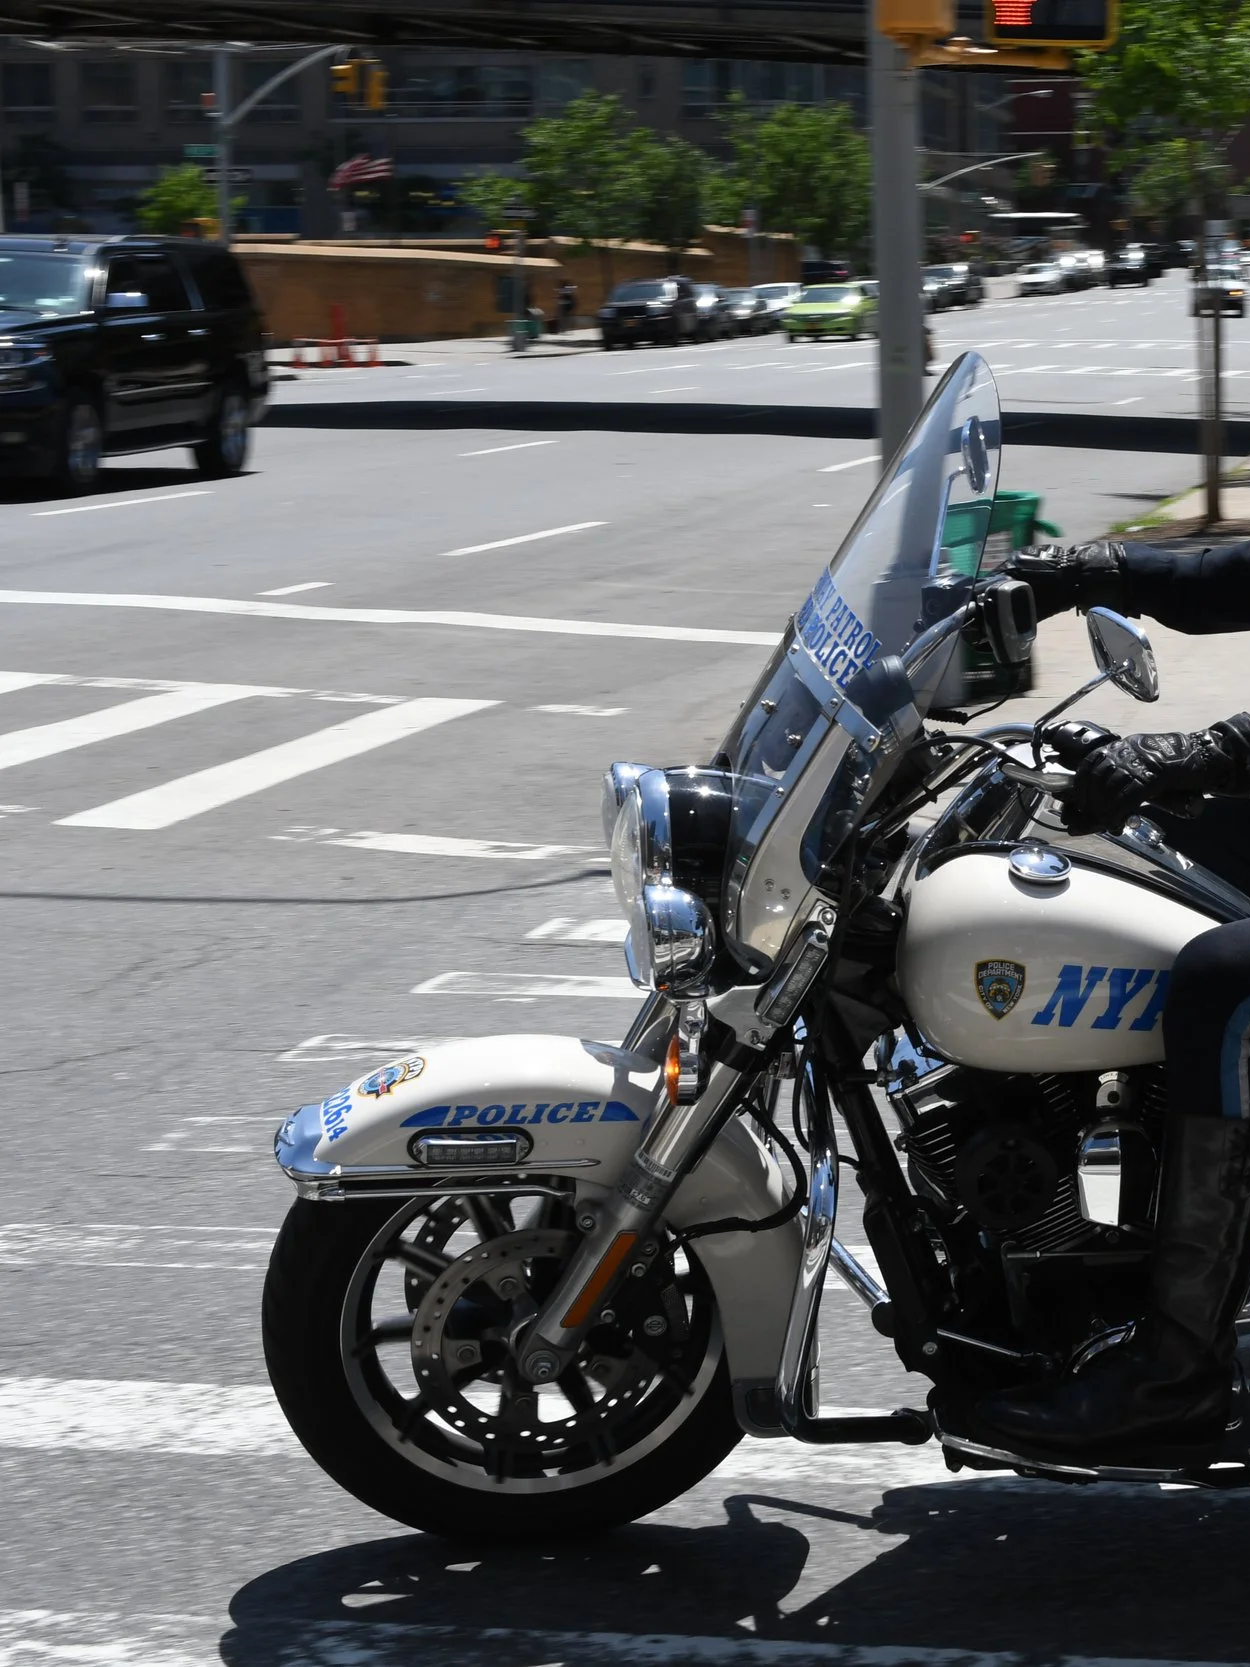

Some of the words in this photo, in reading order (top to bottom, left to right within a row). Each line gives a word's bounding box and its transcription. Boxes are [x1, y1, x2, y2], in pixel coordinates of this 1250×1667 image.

[825, 595, 883, 671] PATROL
[978, 968, 1023, 981] DEPARTMENT
[987, 961, 1015, 971] POLICE
[447, 1101, 600, 1127] POLICE
